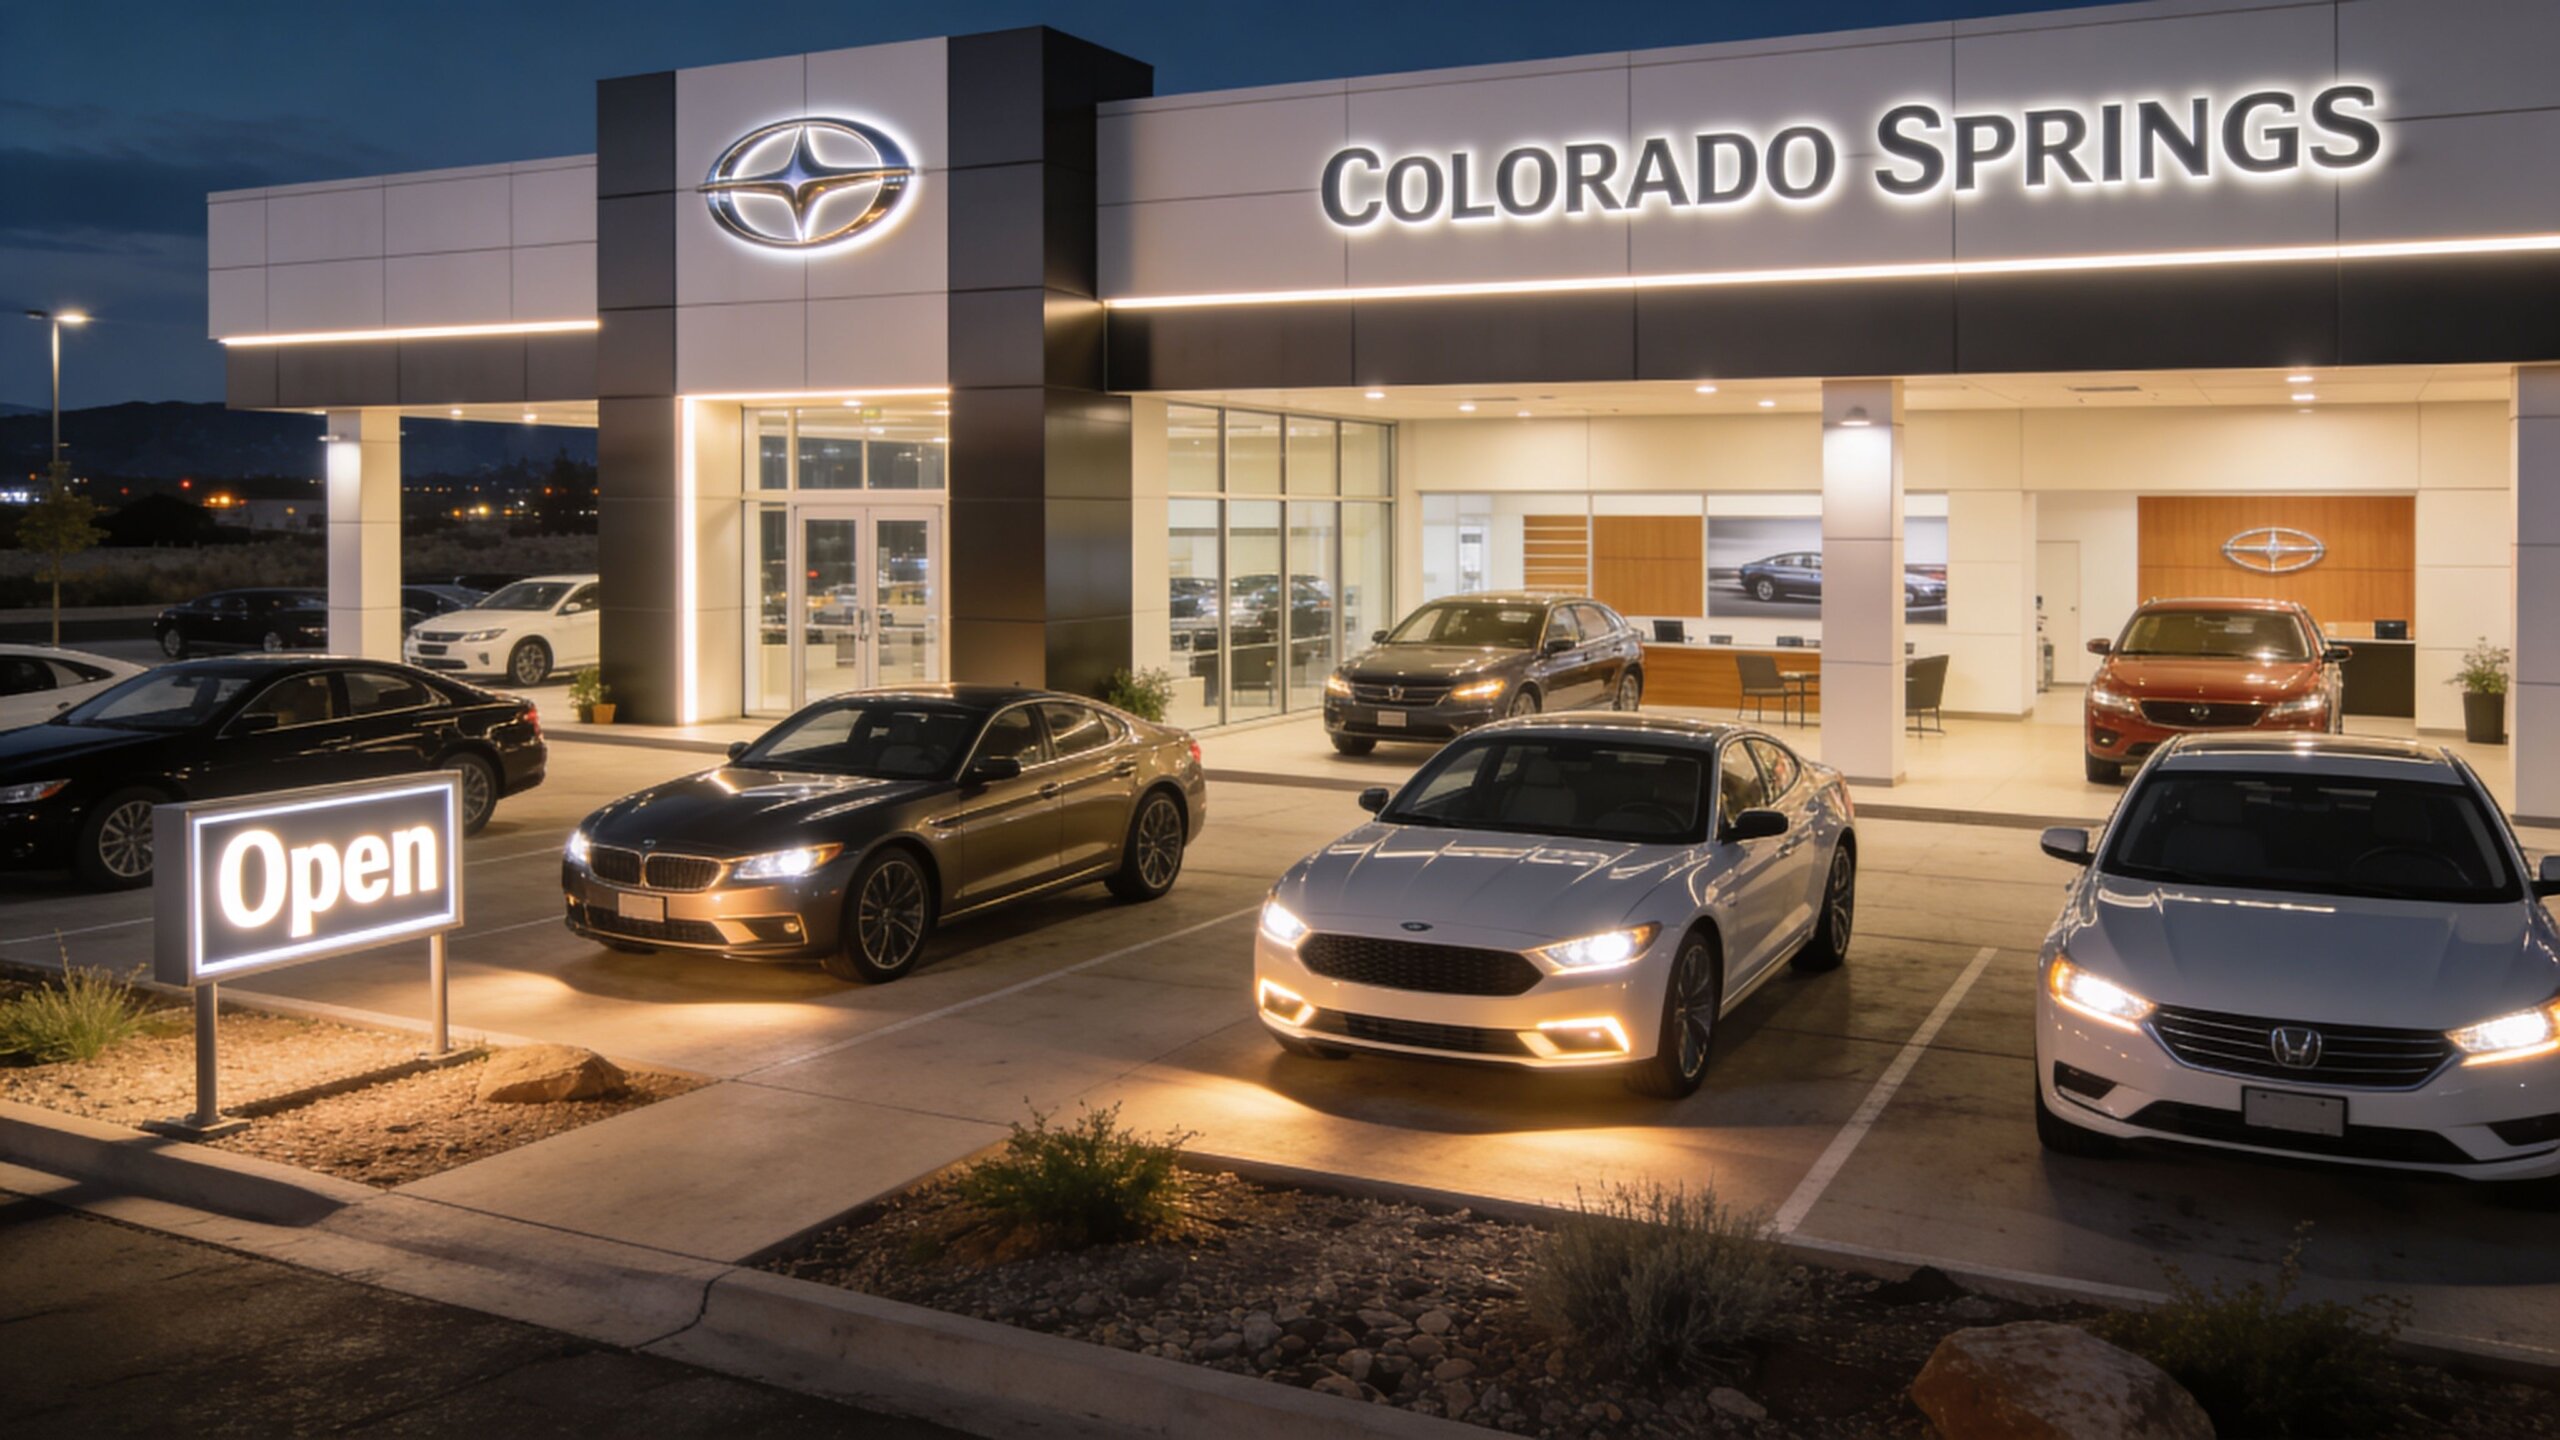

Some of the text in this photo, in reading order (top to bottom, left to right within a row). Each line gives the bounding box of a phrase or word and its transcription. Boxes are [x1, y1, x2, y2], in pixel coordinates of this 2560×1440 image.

[1321, 85, 2381, 227] COLORADO SPRINGS
[219, 825, 438, 938] Open
